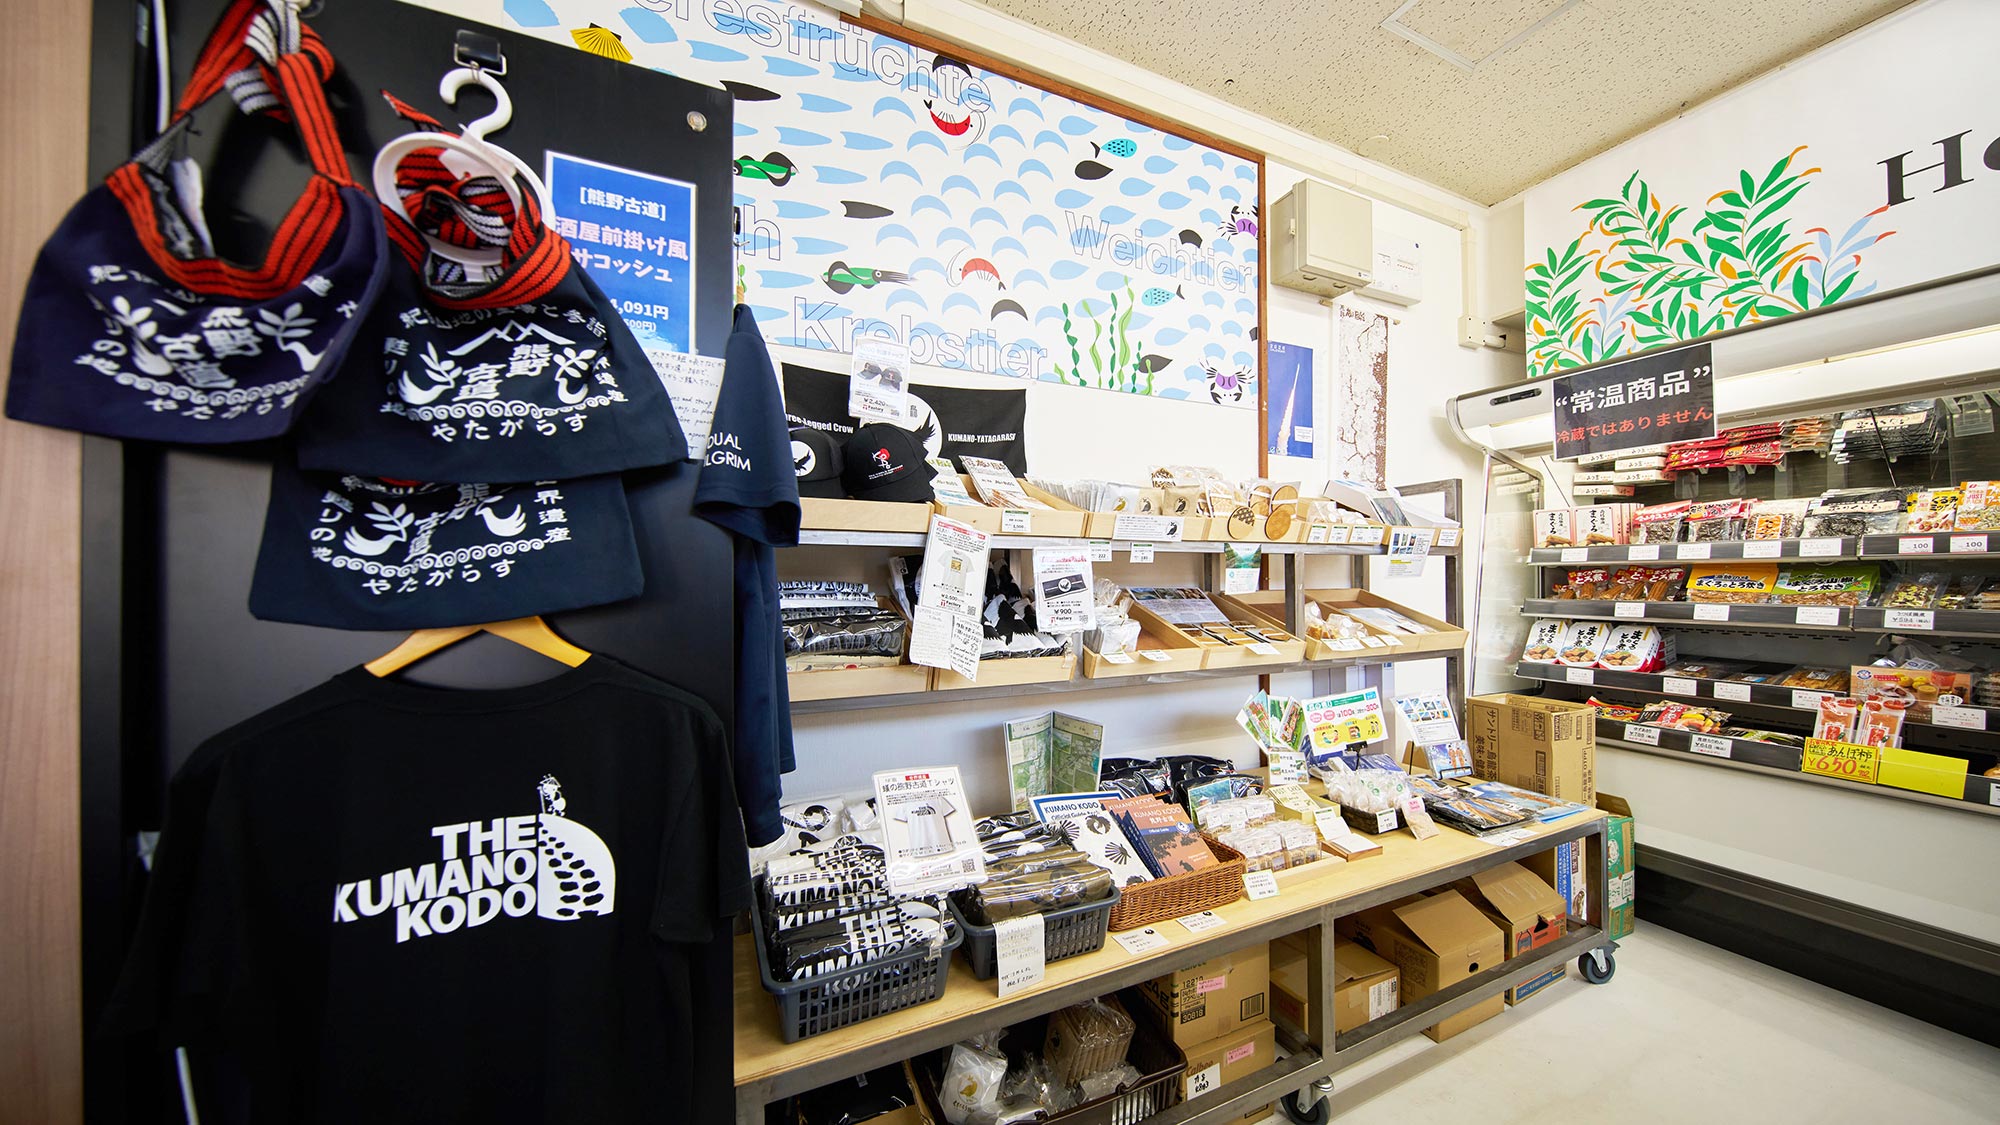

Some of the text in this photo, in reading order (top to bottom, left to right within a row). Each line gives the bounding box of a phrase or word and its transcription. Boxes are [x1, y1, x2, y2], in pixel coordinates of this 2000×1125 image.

[571, 248, 672, 282] サコッシュ
[1065, 210, 1252, 293] Weichtier
[794, 296, 1048, 380] Krebstier
[432, 413, 588, 442] やたがらす
[834, 423, 854, 434] Crow
[1557, 406, 1713, 444] 冷蔵ではありません
[361, 558, 516, 595] やたがらす
[1044, 801, 1099, 814] KUMANO KODO
[1133, 806, 1182, 819] KUMANO KODO
[431, 815, 537, 861] THE
[333, 849, 537, 923] KUMANO
[396, 882, 537, 943] KODO
